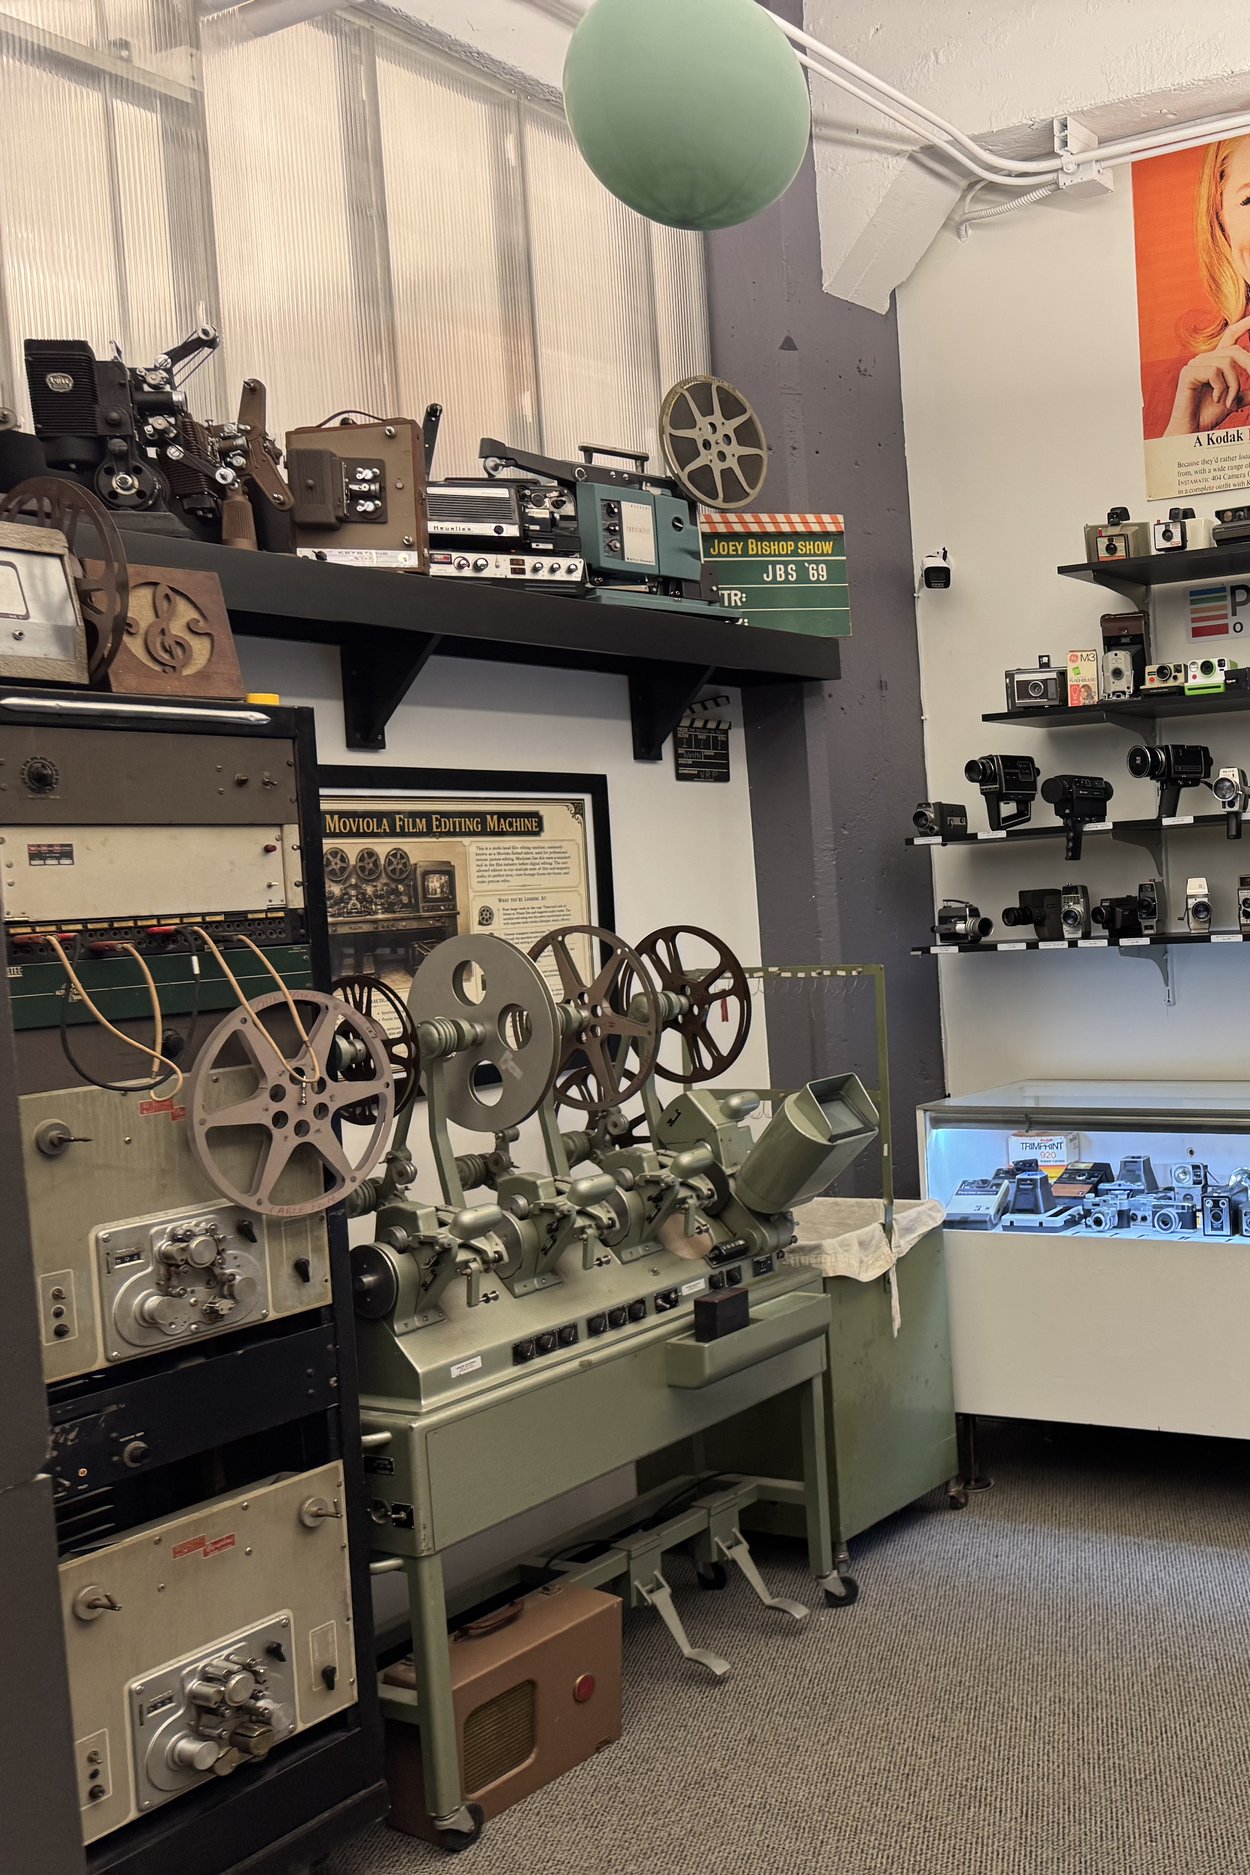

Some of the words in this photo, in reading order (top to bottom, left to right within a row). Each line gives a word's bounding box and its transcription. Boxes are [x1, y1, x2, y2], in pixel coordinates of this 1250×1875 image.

[1193, 435, 1203, 447] A
[1206, 429, 1244, 446] Kodak
[1177, 460, 1203, 468] Because
[1200, 456, 1219, 466] they'd
[1194, 467, 1207, 475] with
[1227, 463, 1244, 471] range
[1222, 472, 1246, 480] Camera
[1188, 485, 1215, 495] complete
[1215, 482, 1231, 490] outfit
[1232, 480, 1246, 488] with
[710, 539, 744, 555] JOEY
[748, 539, 795, 555] BISHOP
[797, 541, 833, 554] SHOW
[763, 564, 797, 581] JBS
[804, 562, 827, 581] '69
[718, 590, 747, 606] TR:
[1080, 652, 1096, 662] M3
[325, 814, 390, 833] MOVIOLA
[395, 814, 427, 832] FILM
[432, 814, 481, 832] EDITING
[486, 814, 539, 832] MACHINE
[1020, 1141, 1064, 1151] TRIMPRINT
[1040, 1151, 1057, 1159] 920
